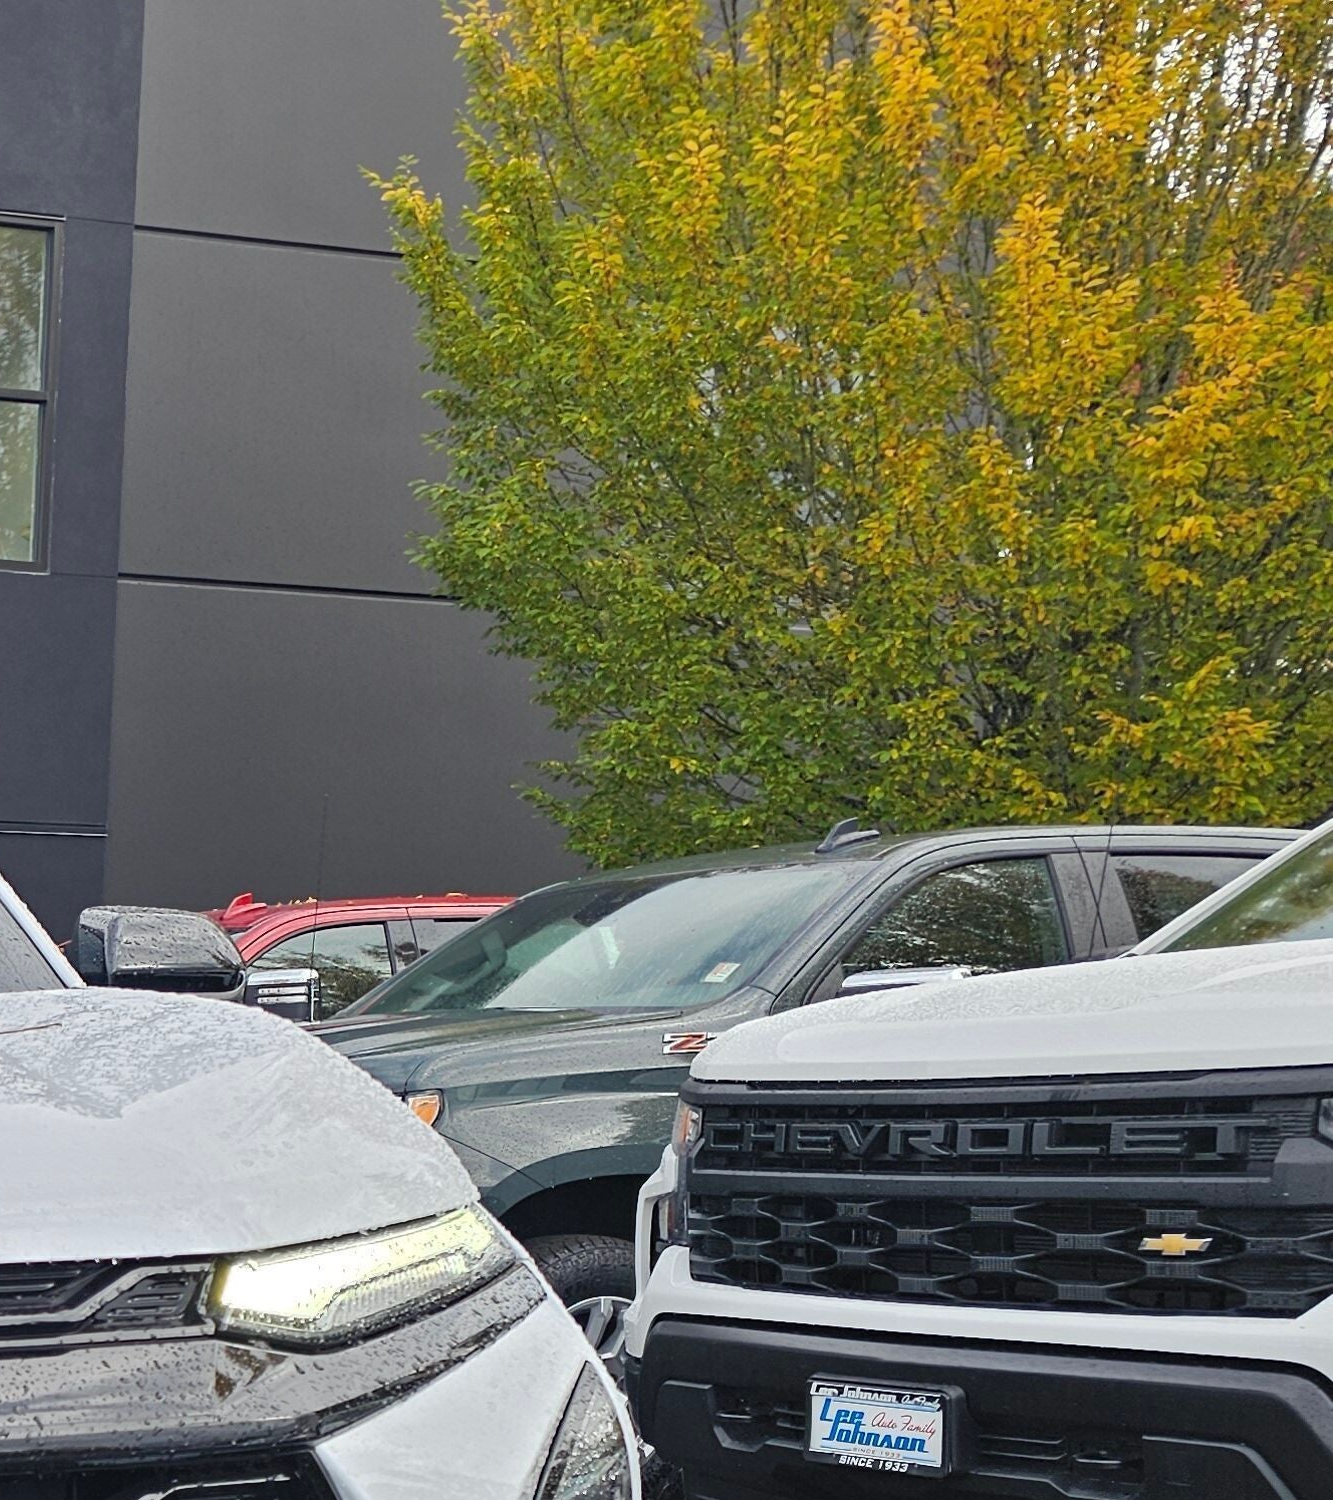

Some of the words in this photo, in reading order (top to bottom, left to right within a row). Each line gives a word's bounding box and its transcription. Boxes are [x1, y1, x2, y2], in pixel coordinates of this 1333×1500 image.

[704, 1116, 1271, 1162] CHEVROLET
[839, 1385, 899, 1404] Johnson
[819, 1397, 866, 1427] Lee
[871, 1412, 898, 1430] Auto
[901, 1415, 937, 1441] Family
[822, 1421, 929, 1453] Johnson
[839, 1455, 875, 1468] SINCE
[878, 1459, 909, 1473] 1933
